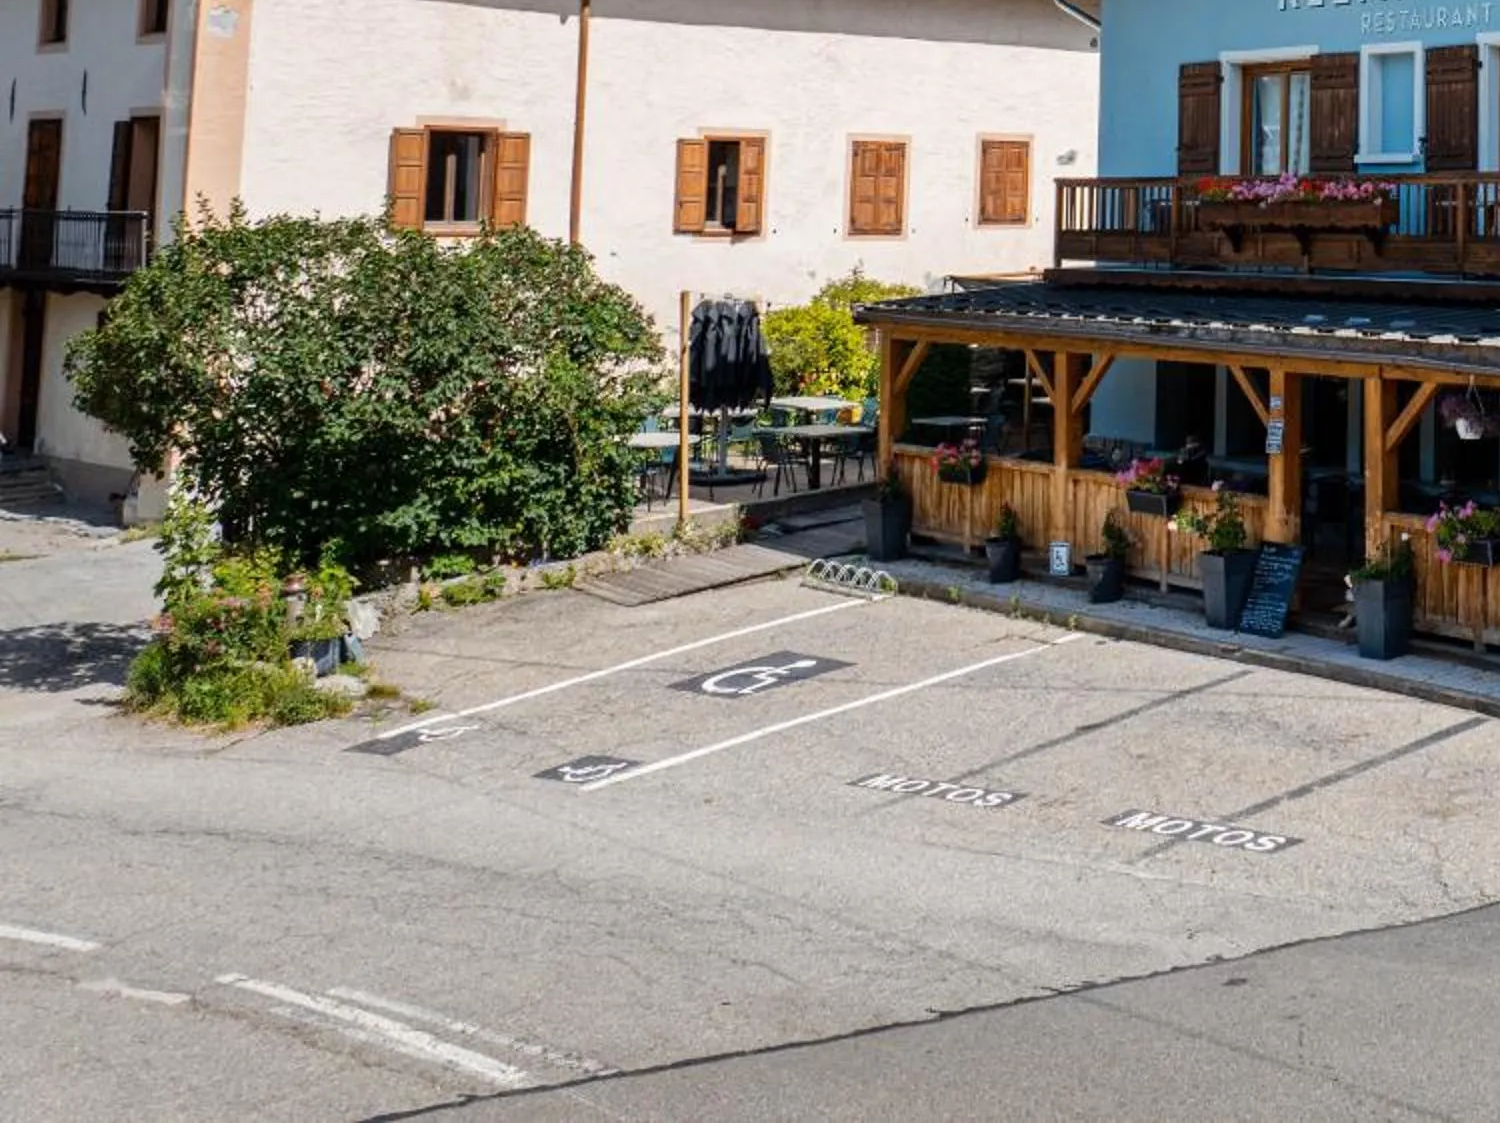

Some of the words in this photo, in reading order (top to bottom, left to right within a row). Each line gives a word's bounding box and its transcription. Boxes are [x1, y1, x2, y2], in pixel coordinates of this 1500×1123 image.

[1359, 2, 1493, 34] RESTAURANT
[863, 773, 1013, 808] MOTOS
[1122, 811, 1287, 853] MOTOS
